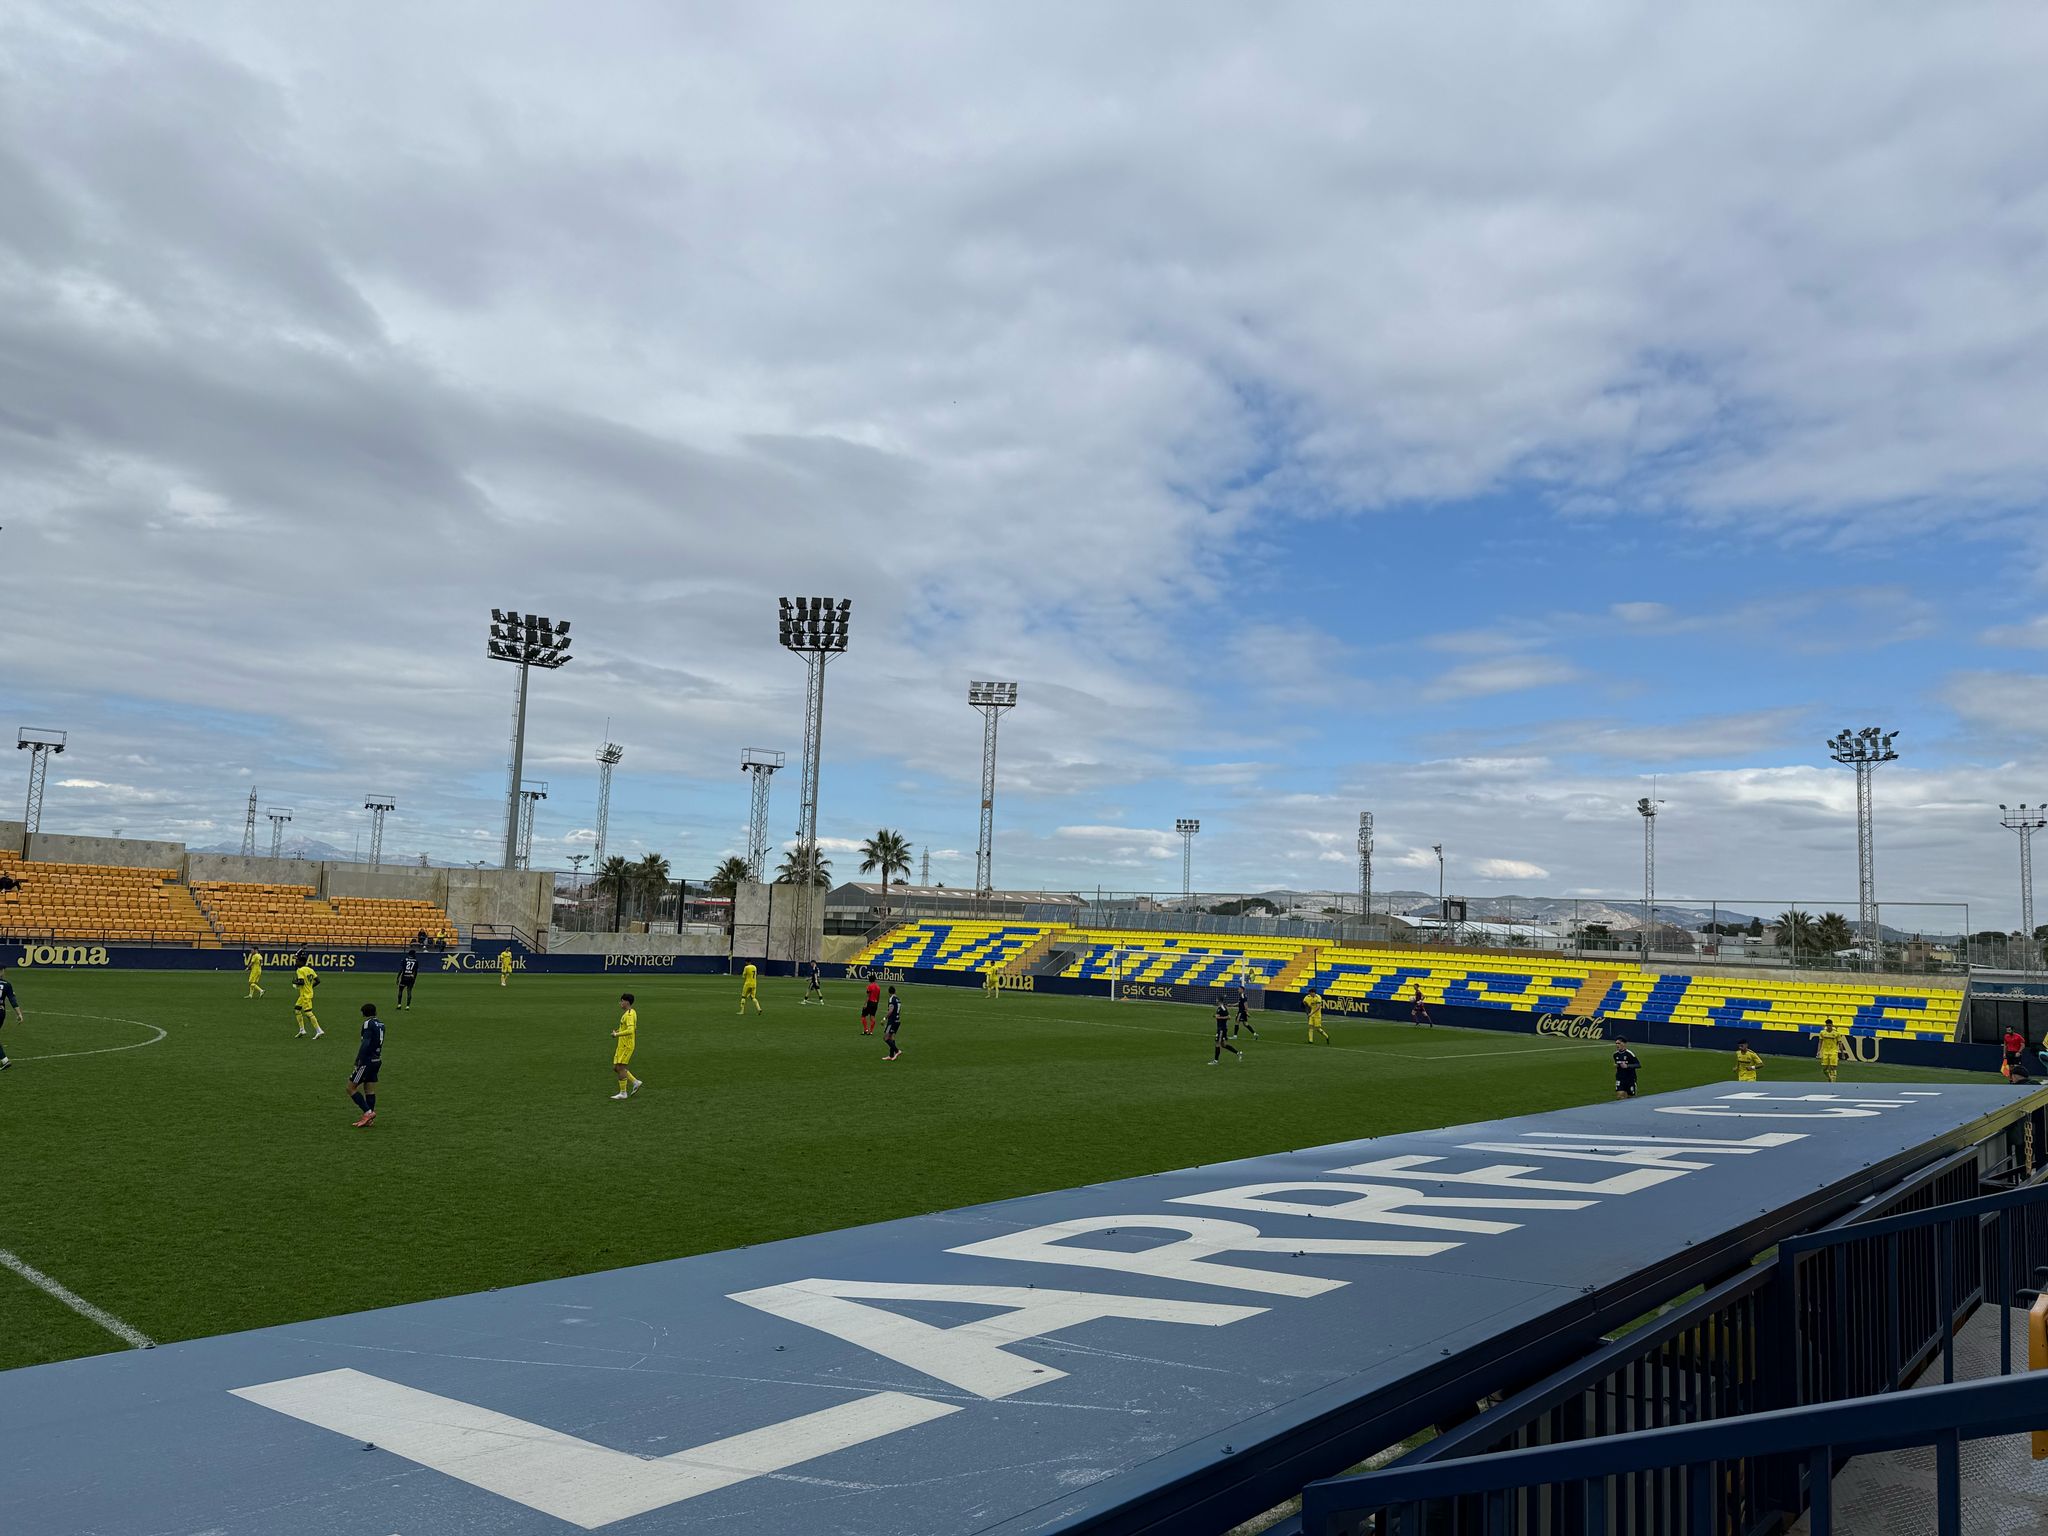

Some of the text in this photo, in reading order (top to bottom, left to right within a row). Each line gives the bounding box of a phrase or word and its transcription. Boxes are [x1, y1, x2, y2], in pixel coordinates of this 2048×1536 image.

[17, 945, 110, 967] Joma
[243, 952, 355, 967] VLARRALCF.ES
[463, 954, 527, 969] CaixaBnk
[405, 961, 415, 970] 27
[983, 974, 1034, 991] oma
[1122, 985, 1172, 997] GSK GSK
[1320, 997, 1370, 1016] NDAVANT
[1536, 1013, 1605, 1039] Coca-Cola
